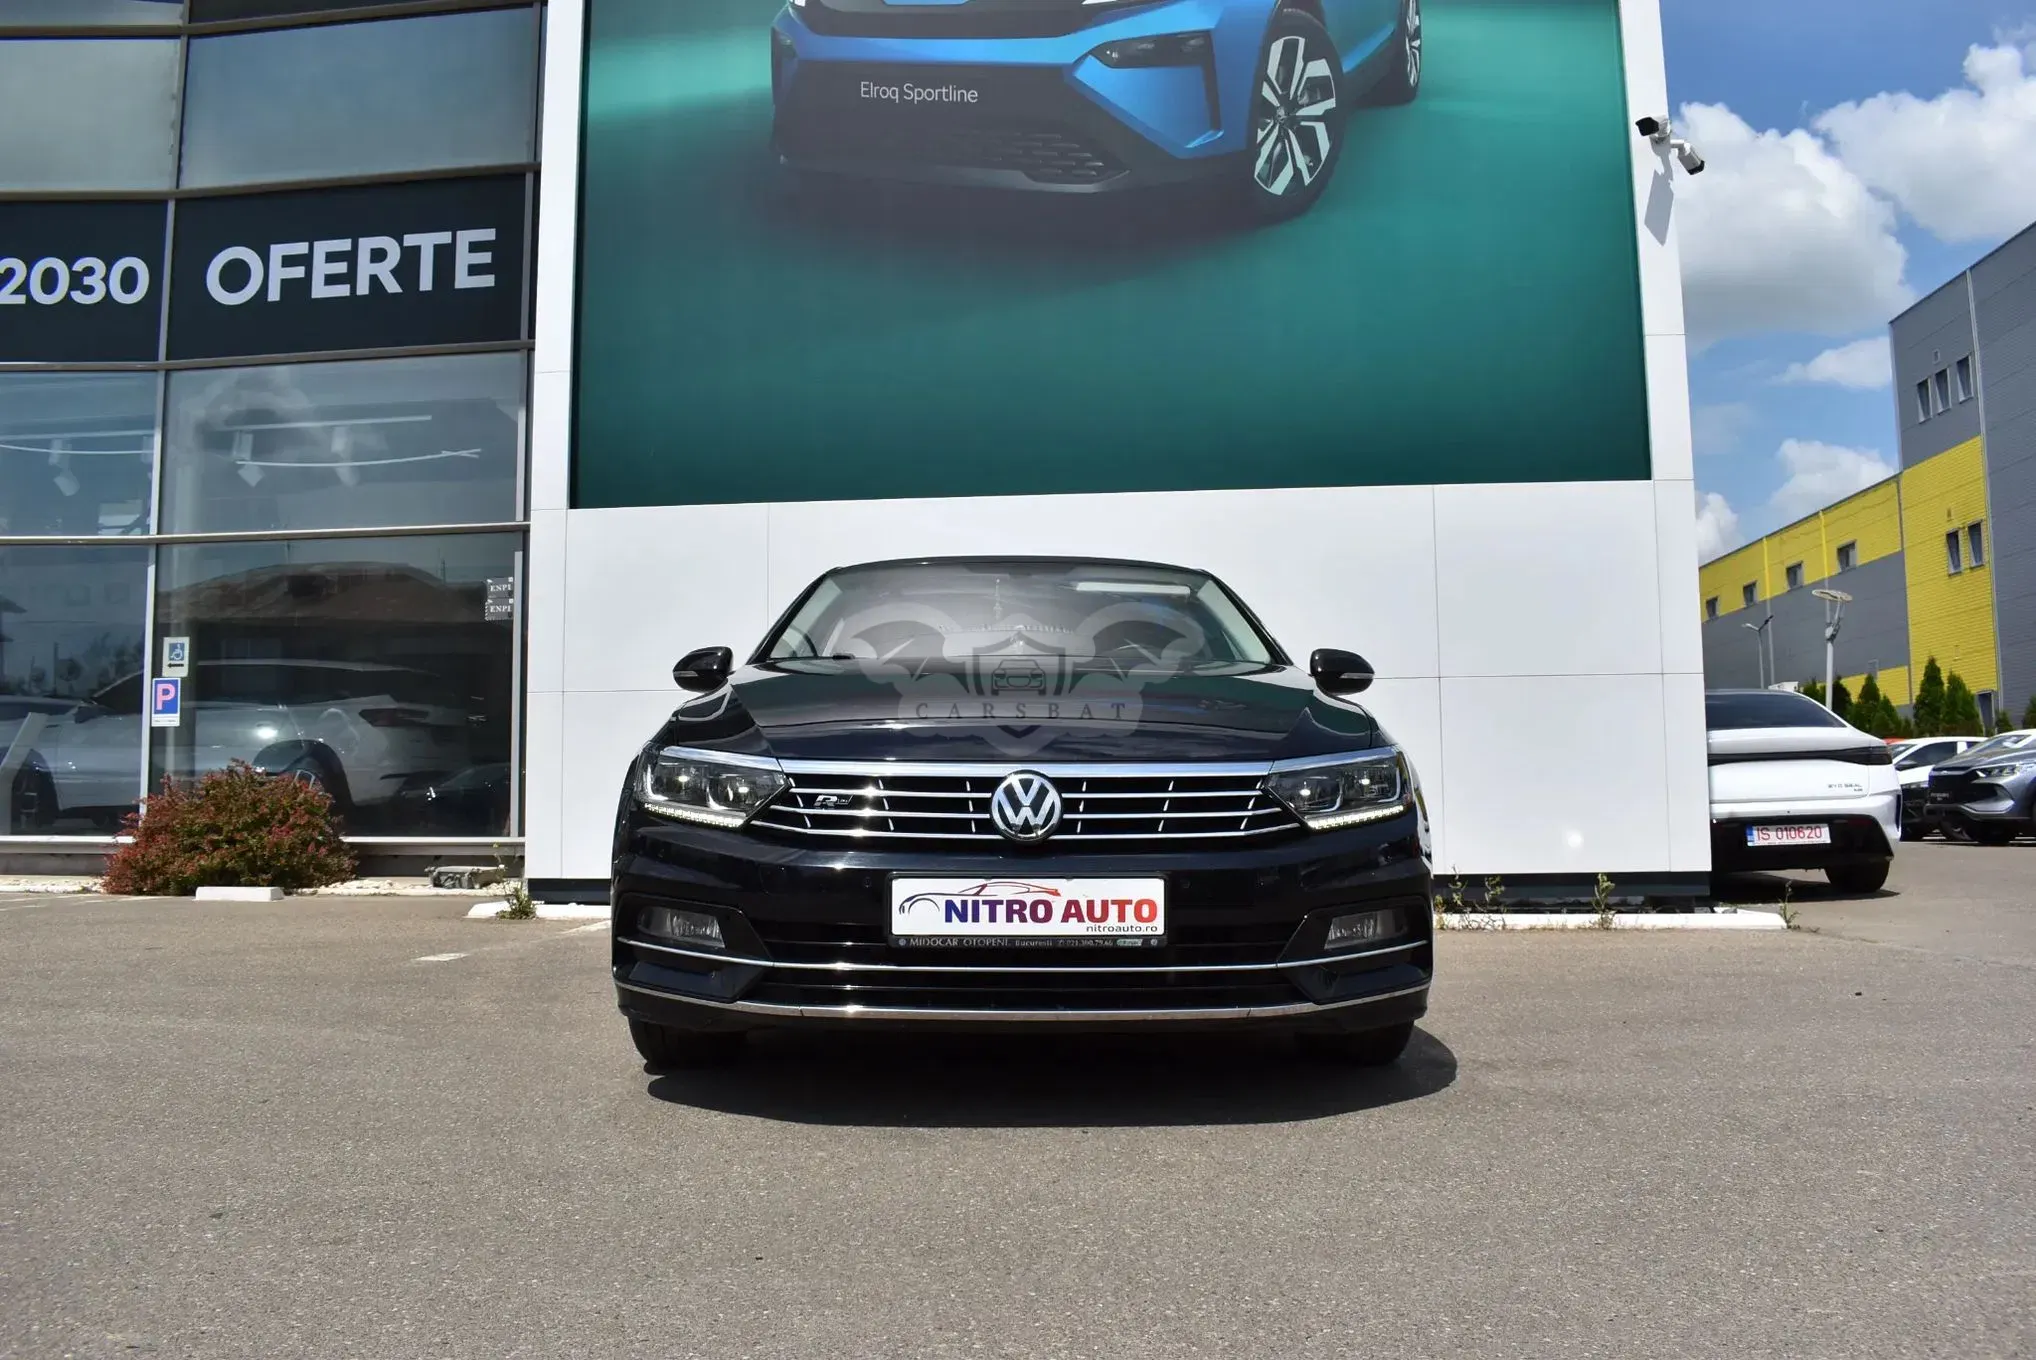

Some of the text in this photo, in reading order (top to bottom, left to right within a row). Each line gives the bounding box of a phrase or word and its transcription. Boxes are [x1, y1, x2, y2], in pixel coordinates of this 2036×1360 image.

[860, 81, 979, 104] Elroq Sportline
[206, 228, 496, 305] OFERTE
[0, 257, 150, 304] 2030
[156, 683, 176, 711] P
[1757, 825, 1823, 841] IS 010620
[944, 899, 1158, 924] NITRO AUTO
[1086, 924, 1158, 933] nitroauto.ro
[909, 938, 958, 946] MIDOCAR
